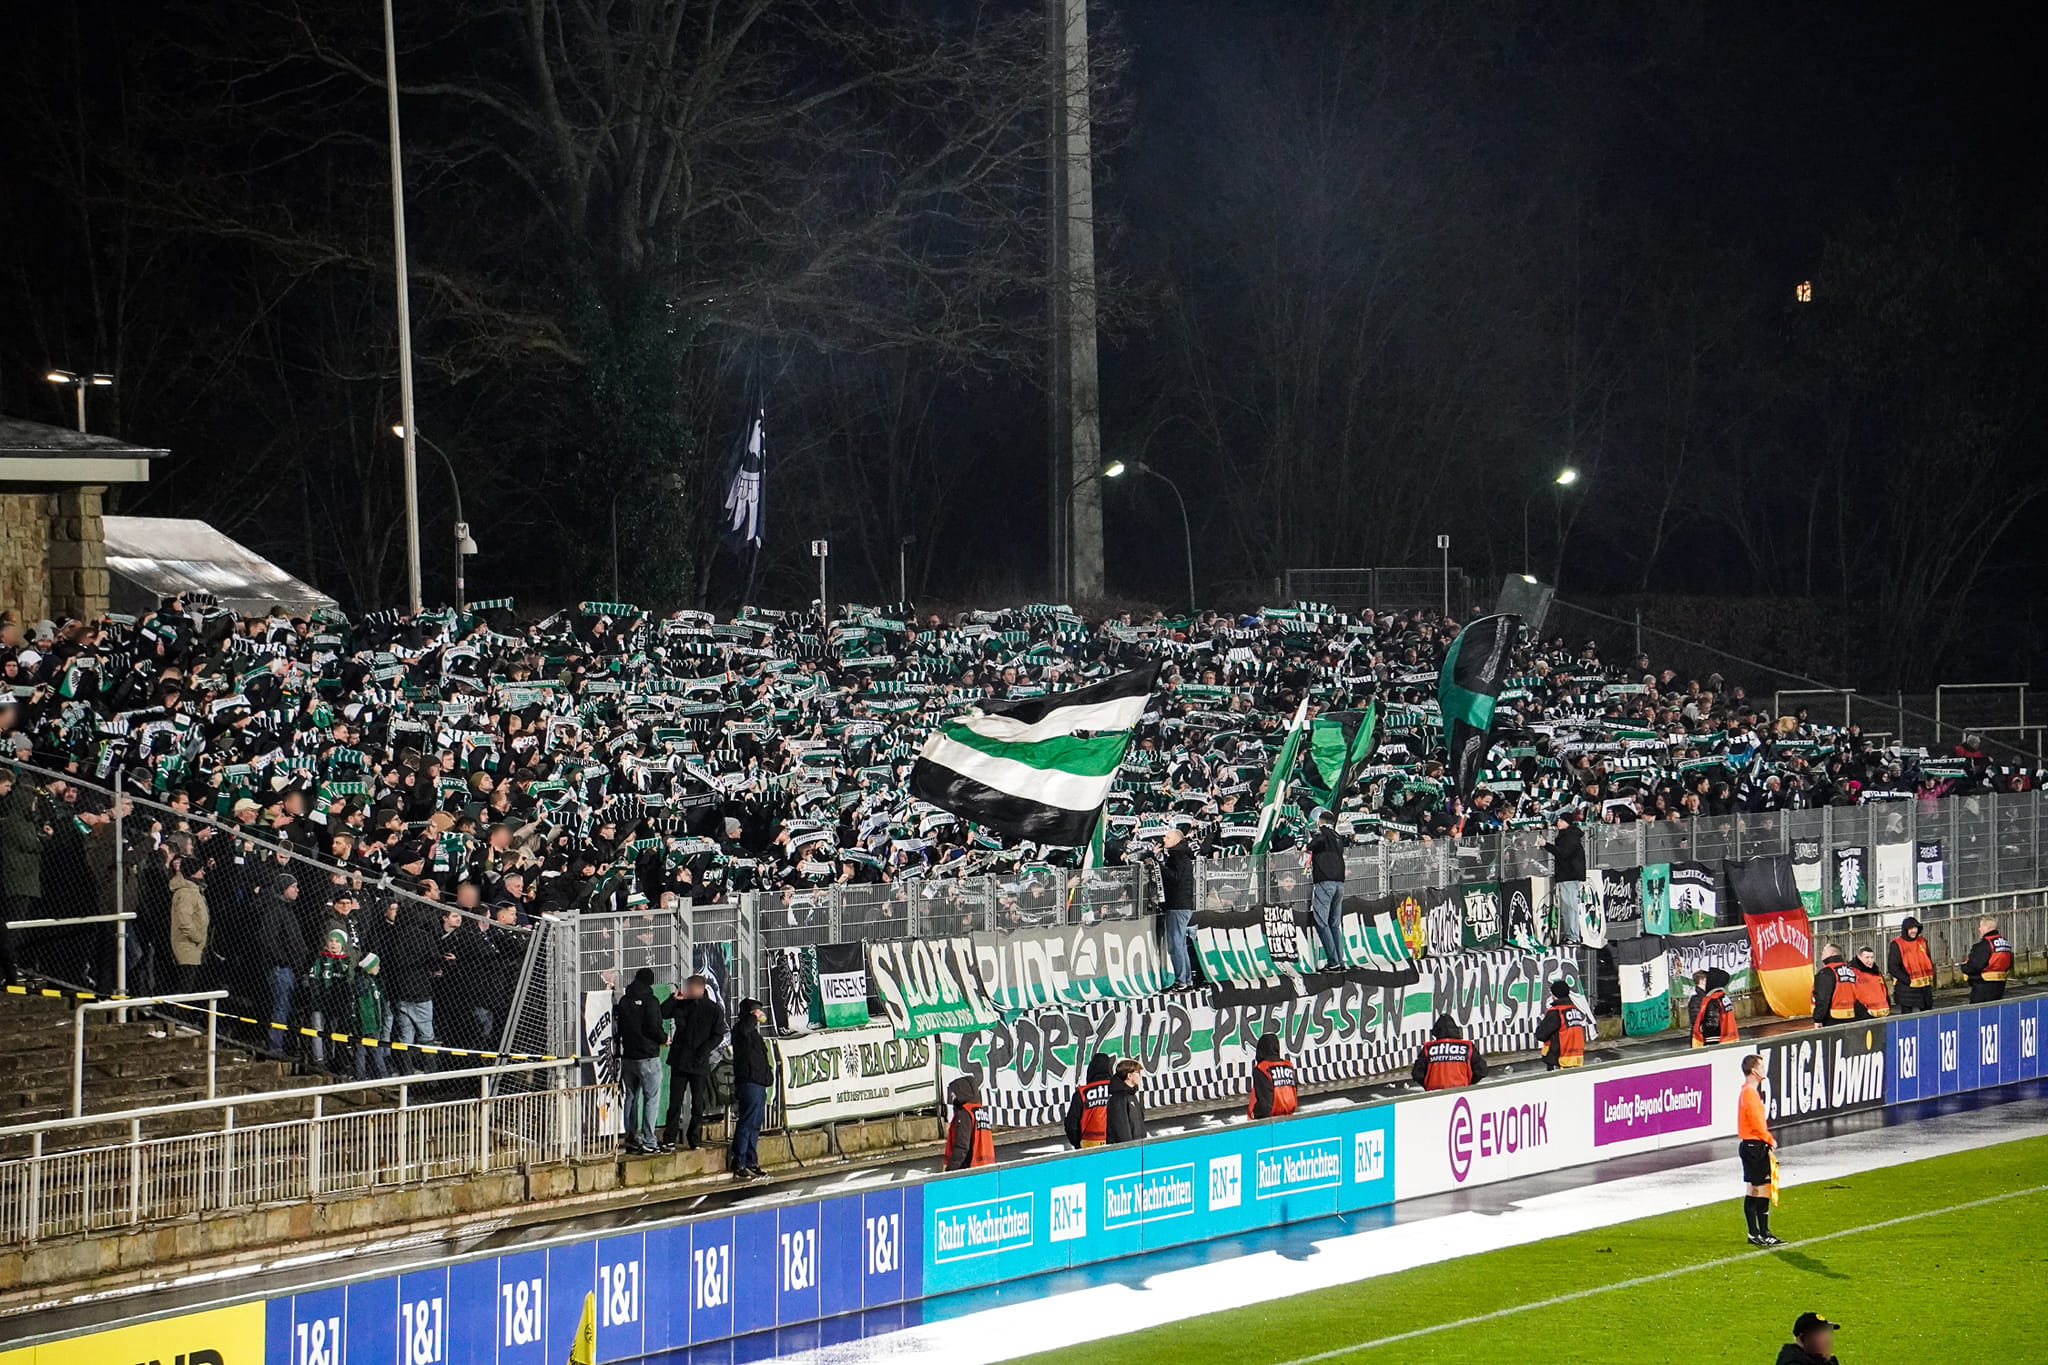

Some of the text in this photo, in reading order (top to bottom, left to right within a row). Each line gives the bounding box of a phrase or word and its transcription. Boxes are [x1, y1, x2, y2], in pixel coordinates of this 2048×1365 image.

[1429, 1042, 1468, 1055] atlas
[1899, 1036, 1916, 1079] 1&1
[1940, 1030, 1956, 1071] 1&1
[1981, 1024, 1998, 1065] 1&1
[2021, 1017, 2036, 1058] 1&1
[787, 1036, 930, 1089] WEST EAGLES
[1780, 1038, 1827, 1118] LIGA
[1832, 1030, 1884, 1108] bwin
[1604, 1087, 1702, 1126] Leading Beyond Chemistry
[1481, 1101, 1547, 1157] EVONIK
[1258, 1146, 1339, 1189] Ruhr Nachrichten
[1356, 1140, 1382, 1173] RN+
[1106, 1179, 1192, 1218] Ruhr Nachrichten
[1211, 1166, 1238, 1200] RN+
[937, 1210, 1030, 1250] Ruhr Nachrichten
[1053, 1198, 1082, 1233] RN+
[782, 1229, 815, 1291] 1&1
[866, 1213, 898, 1275] 1&1
[600, 1261, 639, 1327] 1&1
[695, 1244, 728, 1309] 1&1
[402, 1297, 442, 1365] 1&1
[503, 1278, 541, 1346] 1&1
[297, 1317, 340, 1365] 1&1
